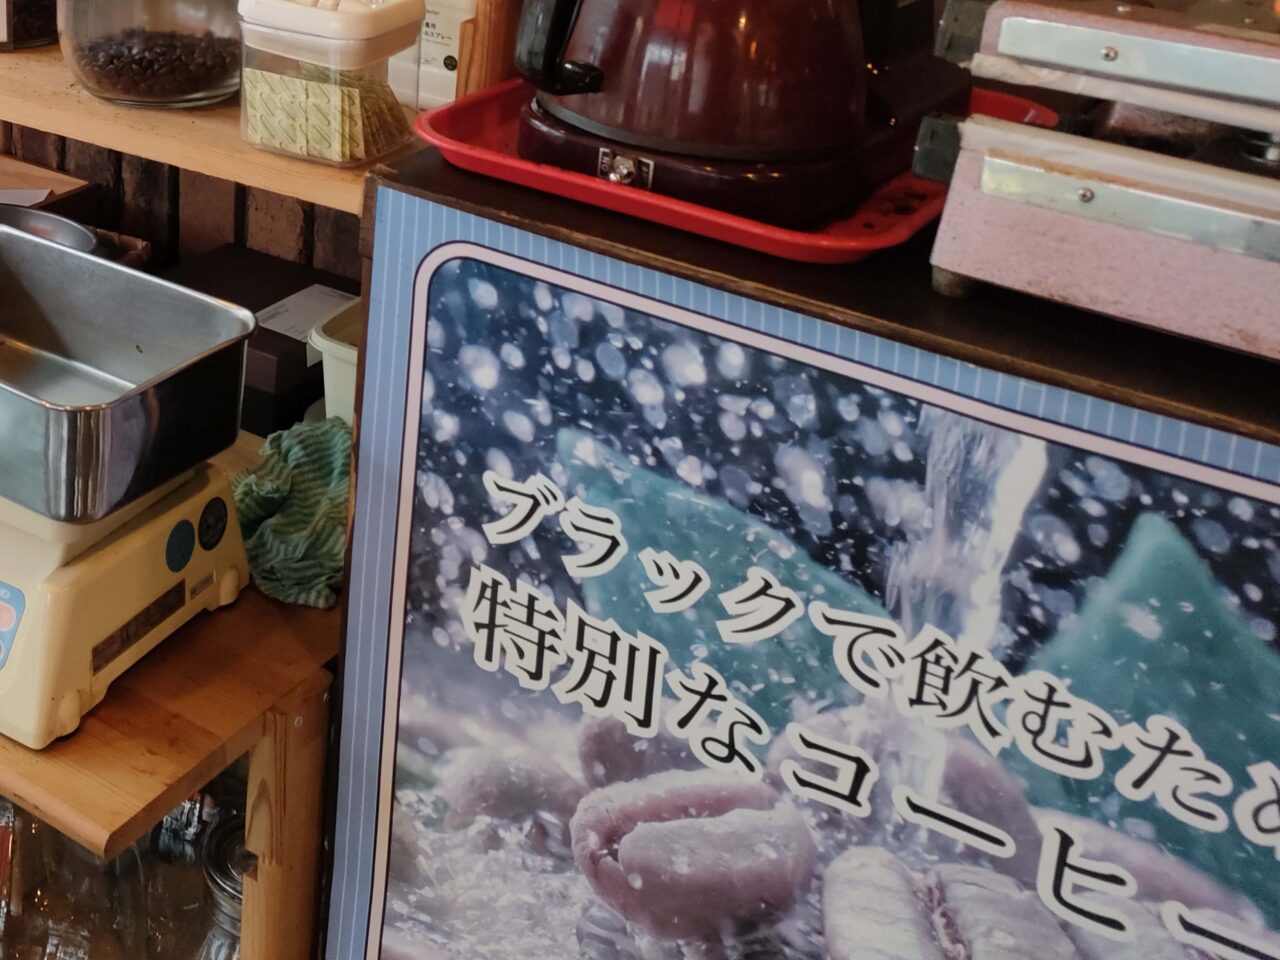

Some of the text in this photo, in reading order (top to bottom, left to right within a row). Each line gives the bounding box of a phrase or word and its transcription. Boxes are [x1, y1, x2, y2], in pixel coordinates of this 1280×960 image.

[473, 577, 1280, 960] 特別なコーヒー
